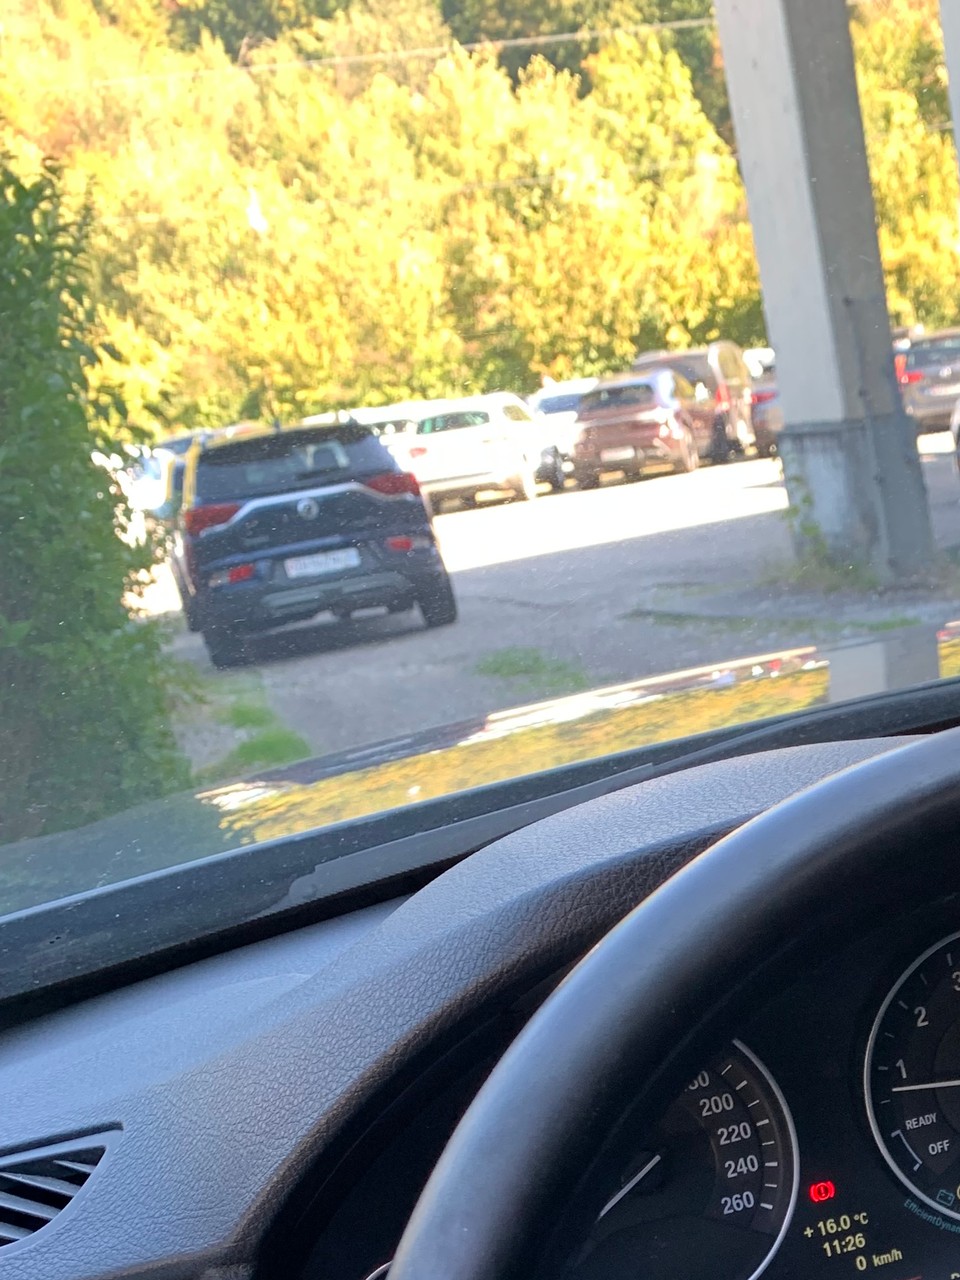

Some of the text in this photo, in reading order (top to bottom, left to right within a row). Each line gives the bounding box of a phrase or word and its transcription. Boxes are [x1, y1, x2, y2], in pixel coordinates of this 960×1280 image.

[914, 1006, 929, 1027] 2
[895, 1059, 907, 1079] 1
[699, 1092, 734, 1117] 200
[905, 1112, 937, 1131] READY
[717, 1121, 751, 1146] 220
[928, 1139, 951, 1156] OFF
[724, 1154, 758, 1178] 240
[720, 1191, 755, 1215] 260
[822, 1232, 866, 1258] 11:26
[856, 1248, 903, 1271] 0 km/h
